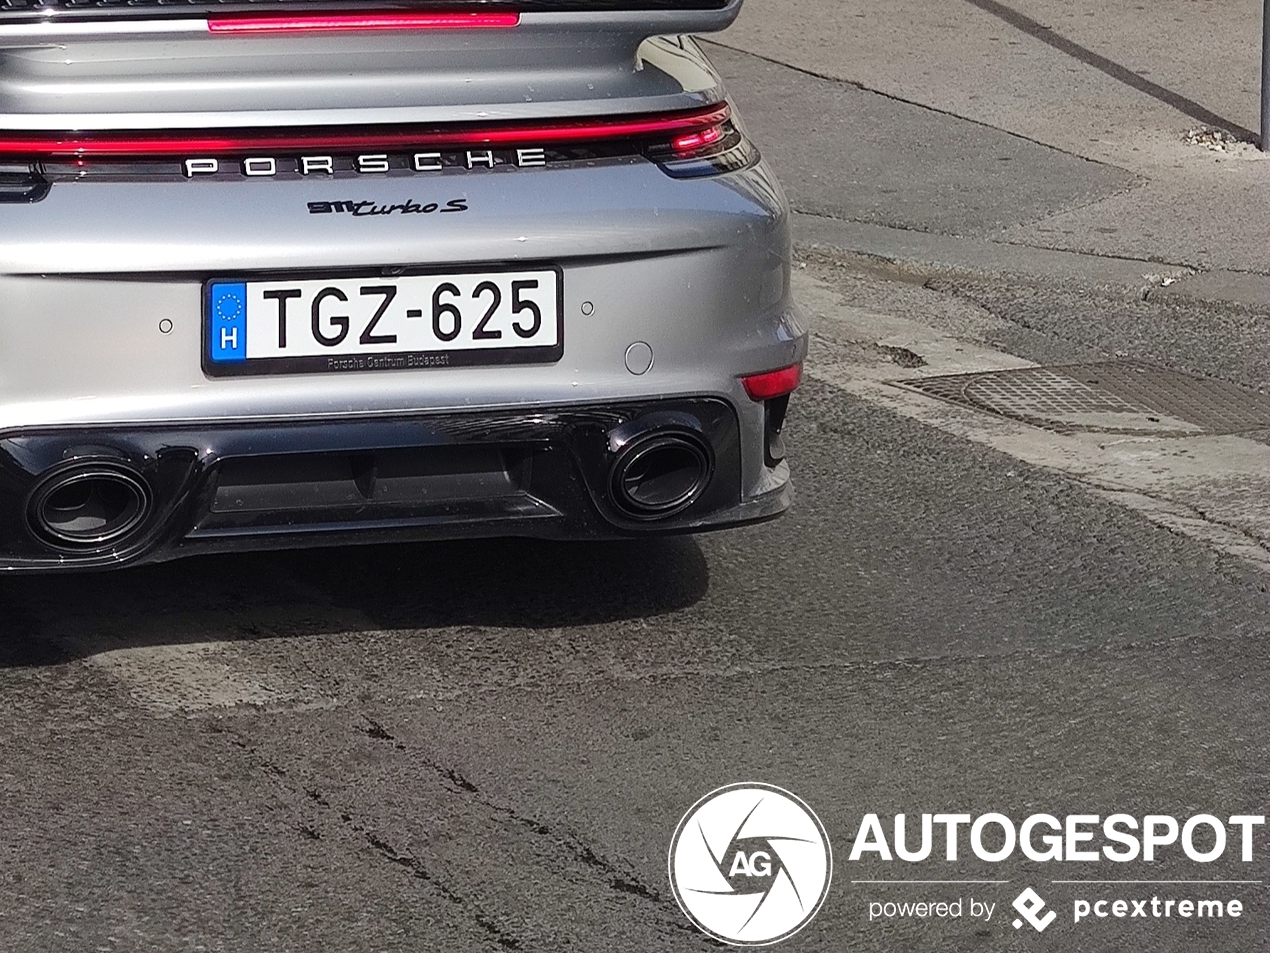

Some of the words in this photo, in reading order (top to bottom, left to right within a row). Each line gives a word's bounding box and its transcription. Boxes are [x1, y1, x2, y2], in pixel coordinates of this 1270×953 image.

[185, 149, 545, 177] PORSCHE
[352, 199, 438, 216] turbo
[440, 199, 468, 213] S
[263, 279, 541, 349] TGZ-625
[221, 327, 237, 349] H
[327, 358, 364, 369] Porsche
[367, 355, 405, 368] Centrum
[407, 353, 450, 367] Budapest
